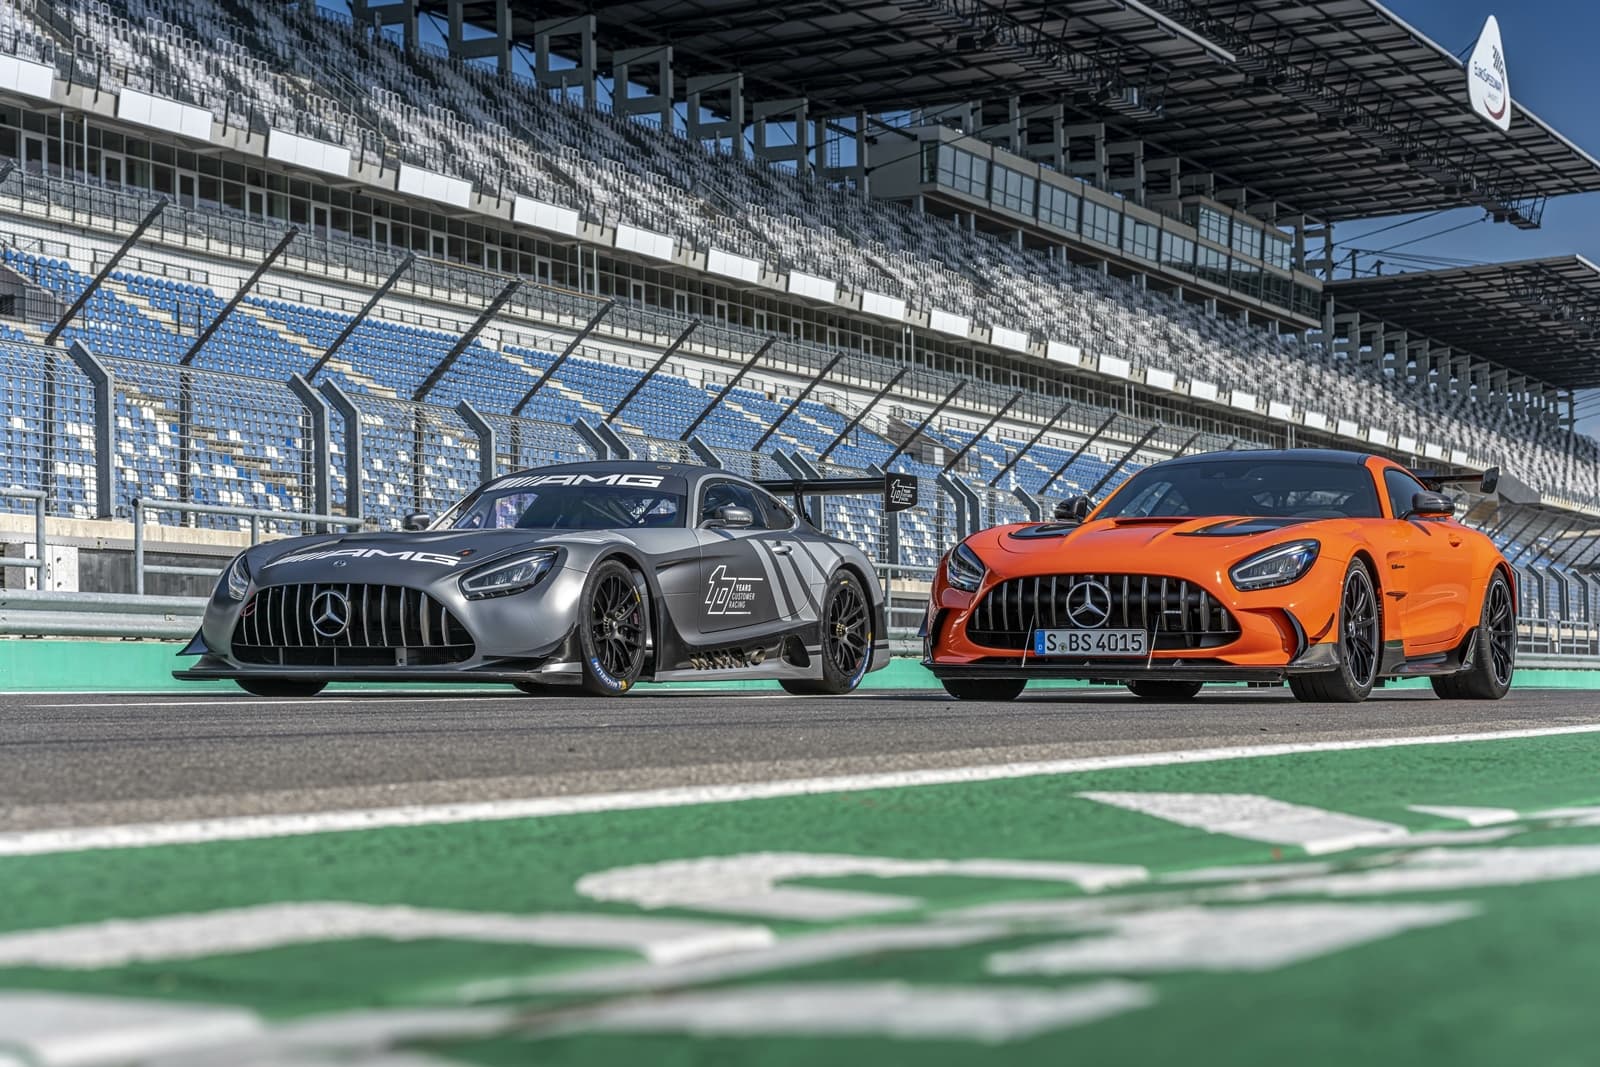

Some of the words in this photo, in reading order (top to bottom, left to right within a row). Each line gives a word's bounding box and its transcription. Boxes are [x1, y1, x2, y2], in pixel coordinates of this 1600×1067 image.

[532, 474, 664, 488] AMG
[322, 548, 462, 567] AMG
[736, 584, 751, 592] YEARS
[731, 592, 756, 601] CUSTOMER
[728, 601, 746, 609] RACING
[1046, 633, 1057, 651] S
